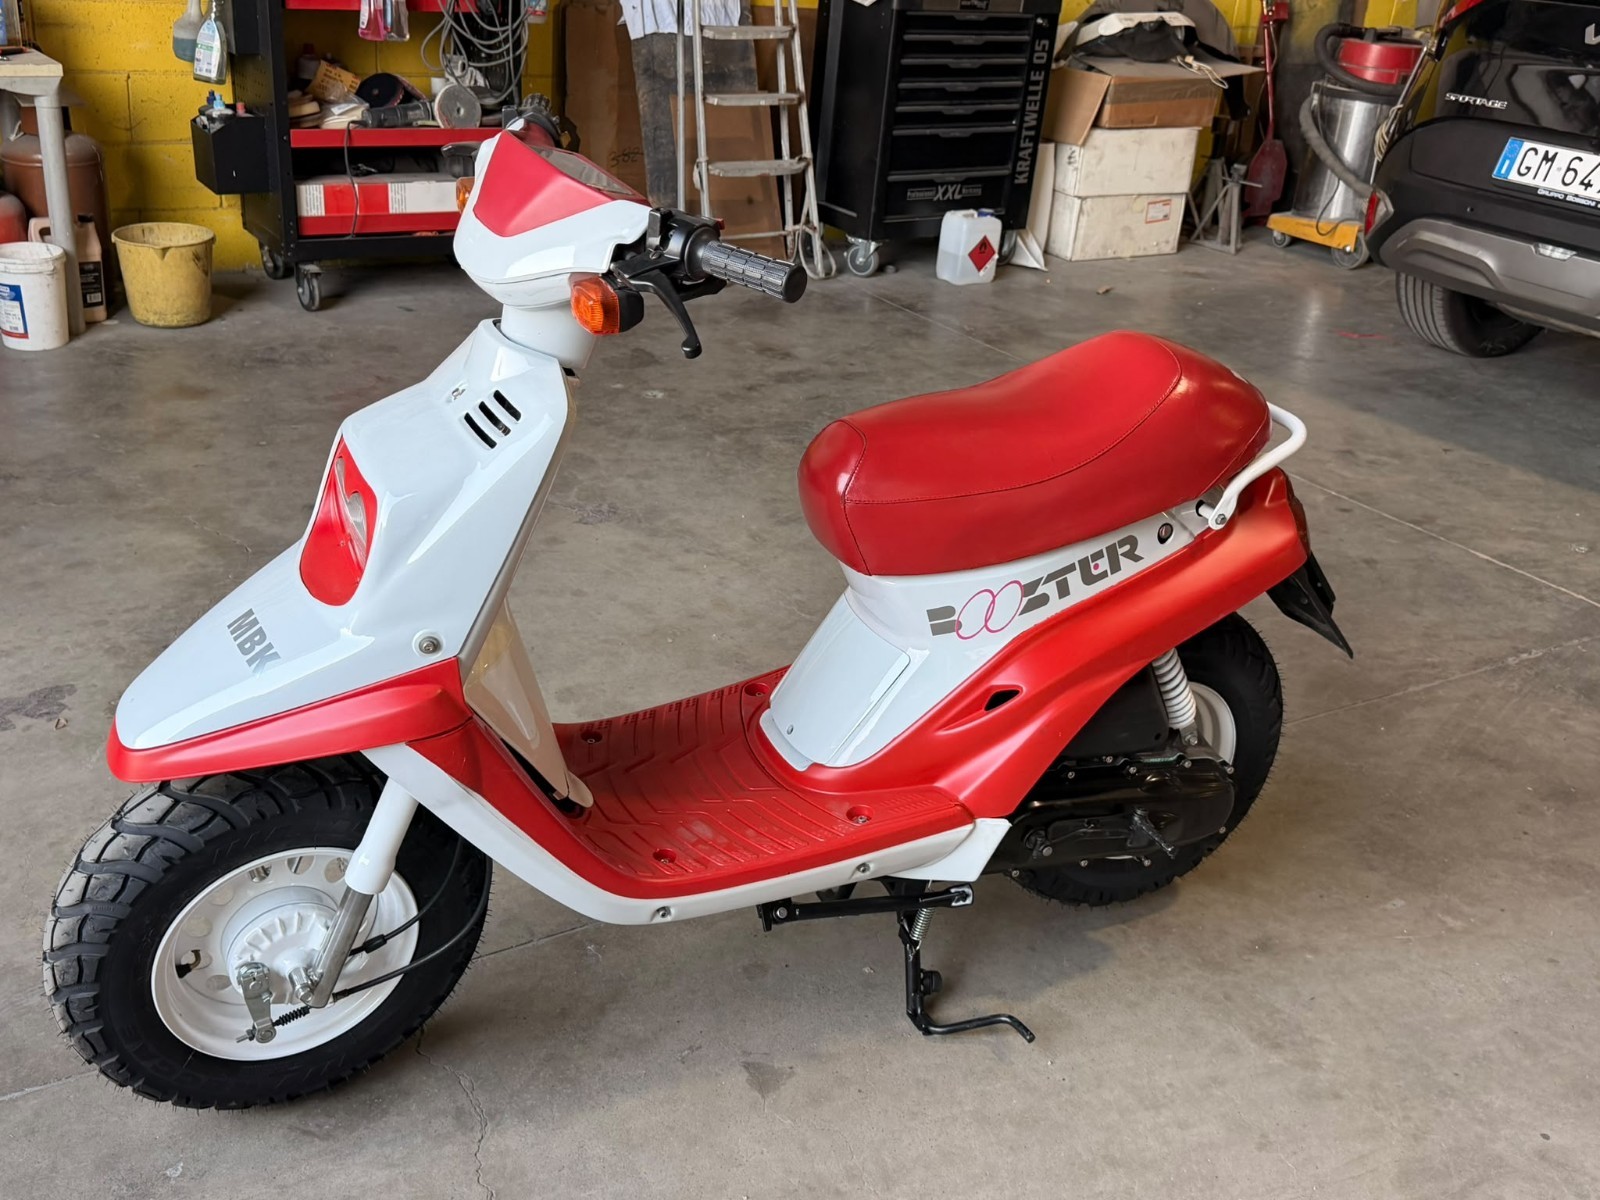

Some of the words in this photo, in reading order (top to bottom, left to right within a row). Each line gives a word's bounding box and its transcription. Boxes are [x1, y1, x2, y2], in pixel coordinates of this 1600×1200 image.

[1014, 70, 1045, 184] KRAFTWELLE
[1032, 38, 1050, 64] 05
[1445, 92, 1508, 110] SPORTAGE
[1501, 159, 1510, 174] I
[1517, 147, 1559, 182] GM
[1561, 156, 1600, 194] 64
[933, 184, 962, 201] XXL
[926, 534, 1145, 640] BOOSTER
[226, 607, 282, 675] MBK
